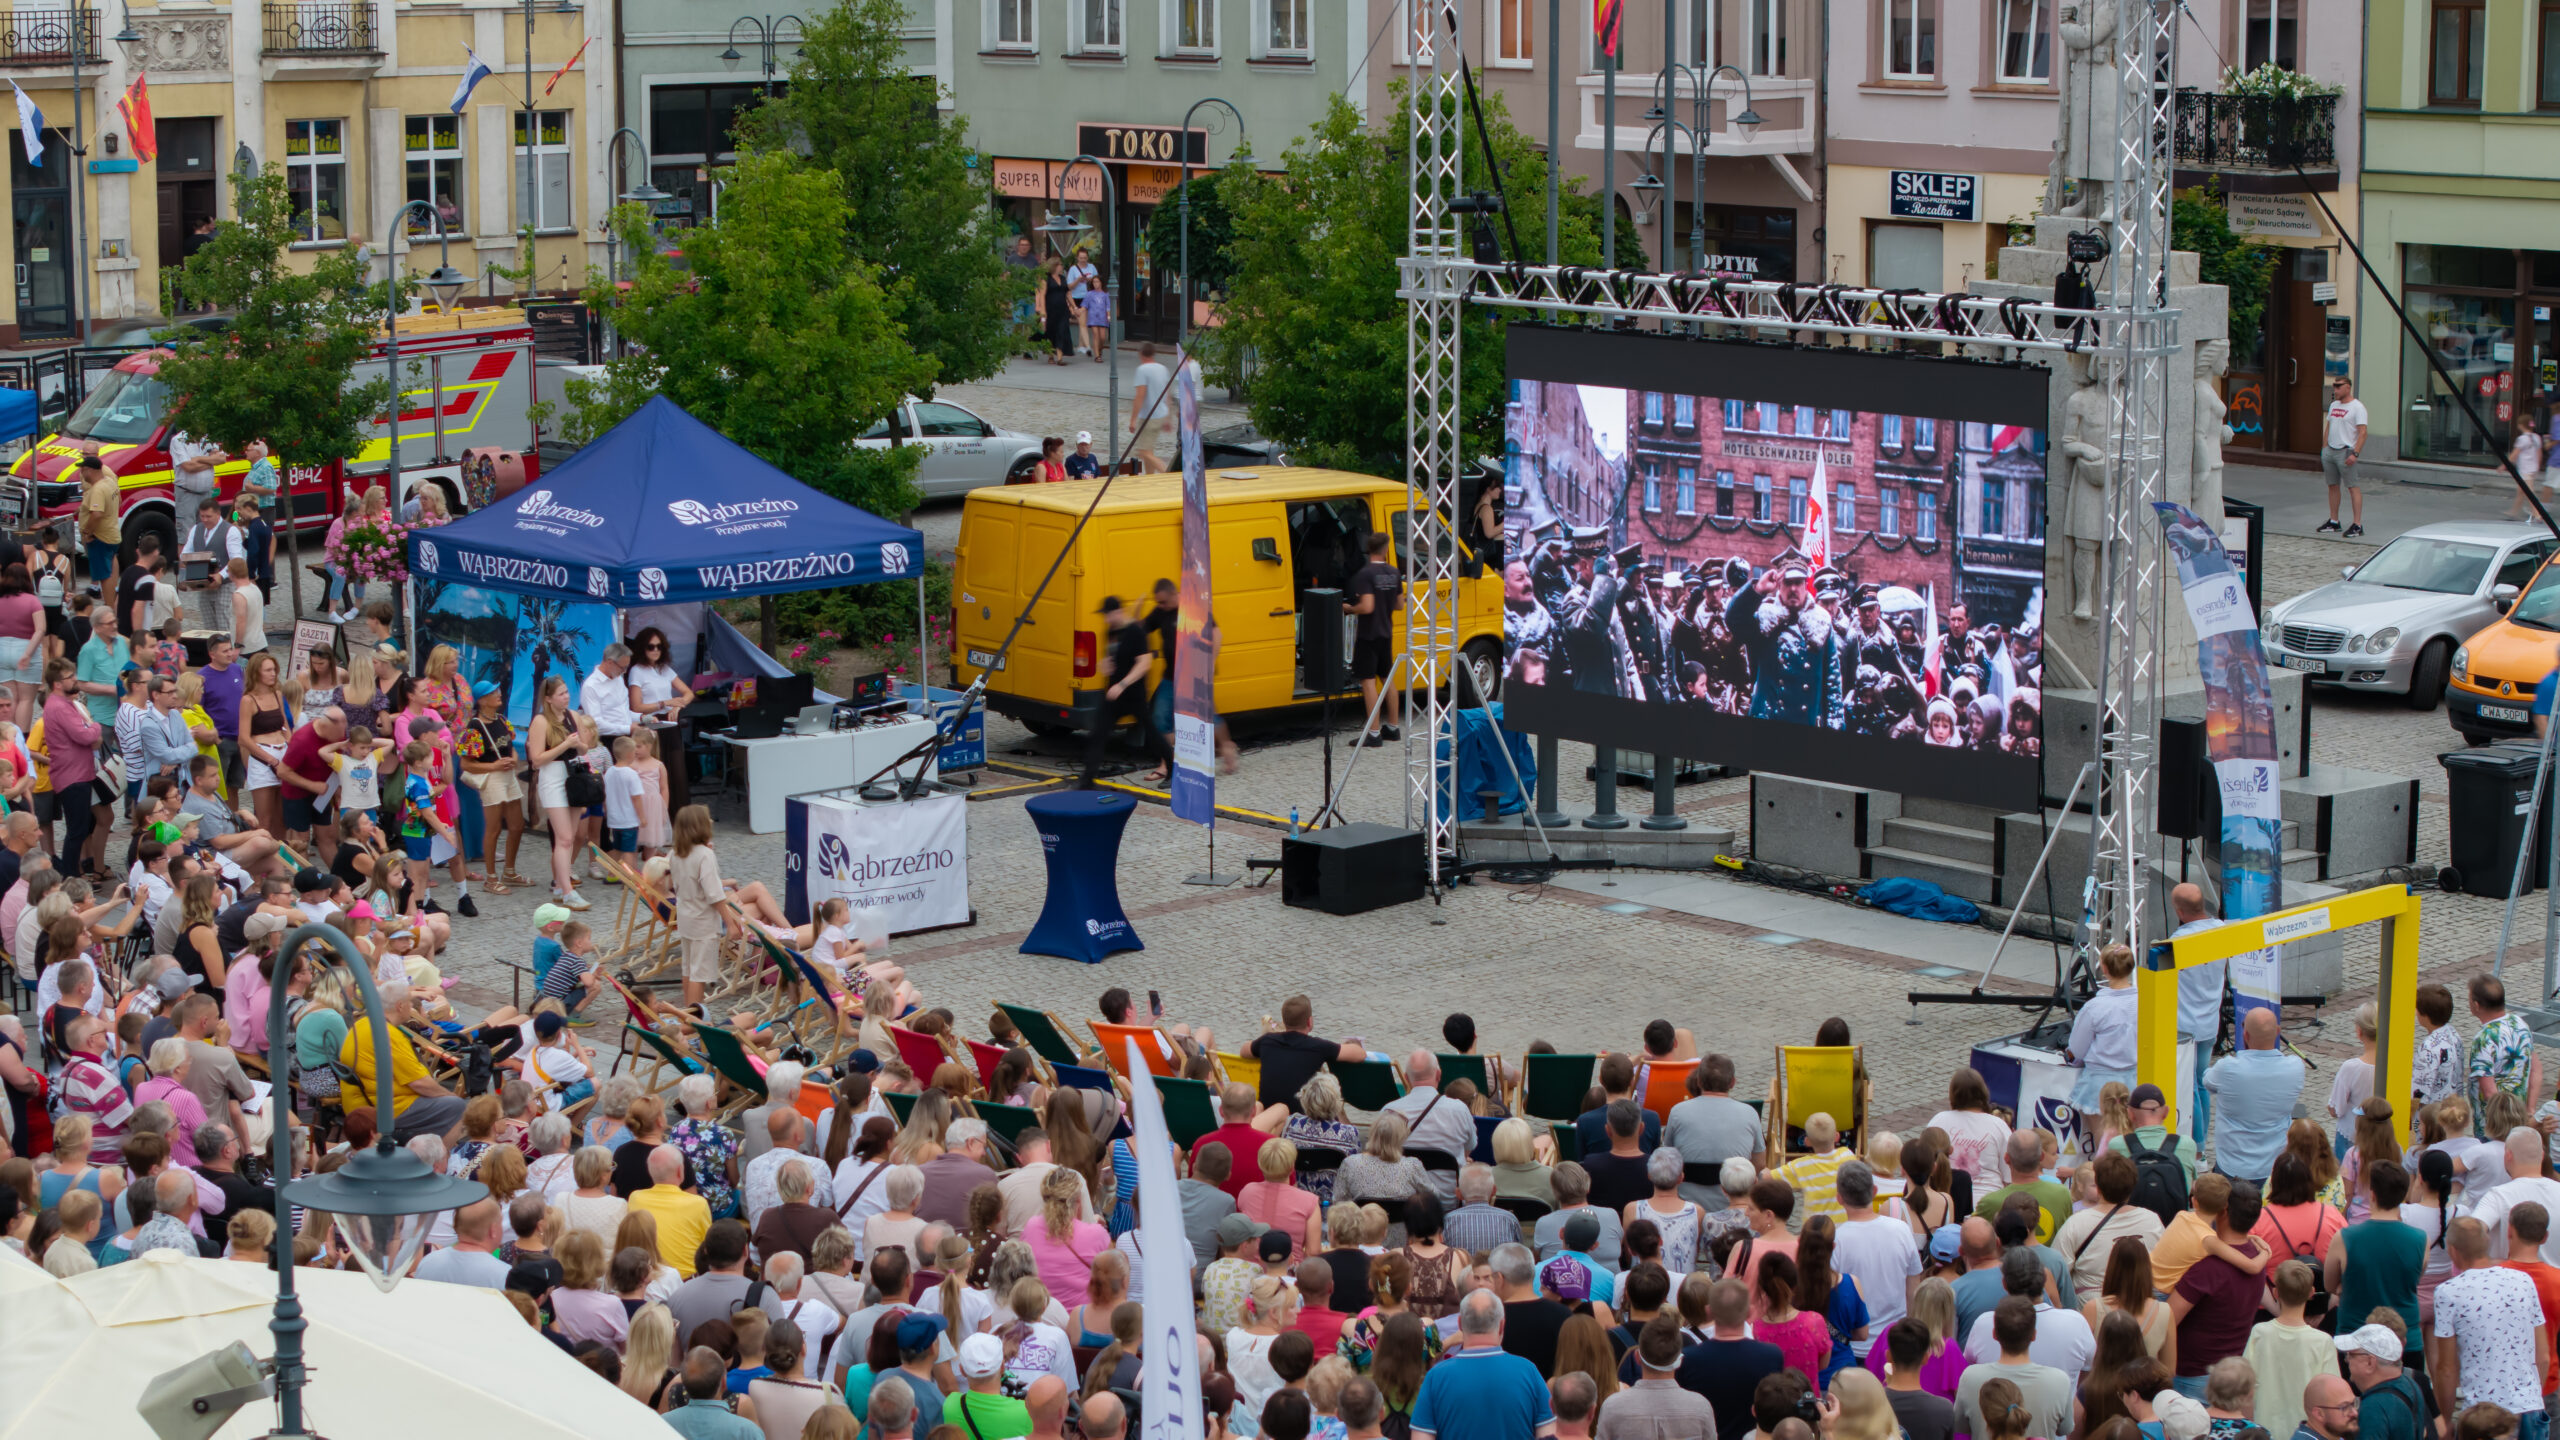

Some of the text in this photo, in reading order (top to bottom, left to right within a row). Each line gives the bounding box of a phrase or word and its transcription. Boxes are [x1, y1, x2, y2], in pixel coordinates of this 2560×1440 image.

[1105, 129, 1174, 160] TOKO
[1000, 172, 1040, 188] SUPER
[1152, 168, 1174, 184] 1001
[1897, 173, 1971, 197] SKLEP
[2233, 194, 2271, 203] Kancelaria
[2243, 206, 2304, 218] Mediator Sądowy
[2257, 218, 2312, 230] Nieruchomości
[1724, 443, 1756, 456] HOTEL
[1759, 446, 1818, 461] SCHWARZER
[715, 519, 787, 536] Przyjazne wody
[457, 551, 568, 588] WĄBRZEŹNO
[698, 552, 855, 592] WĄBRZEŹNO
[300, 627, 329, 641] GAZETA
[2482, 706, 2528, 722] CWA 50PU
[898, 886, 926, 903] wody
